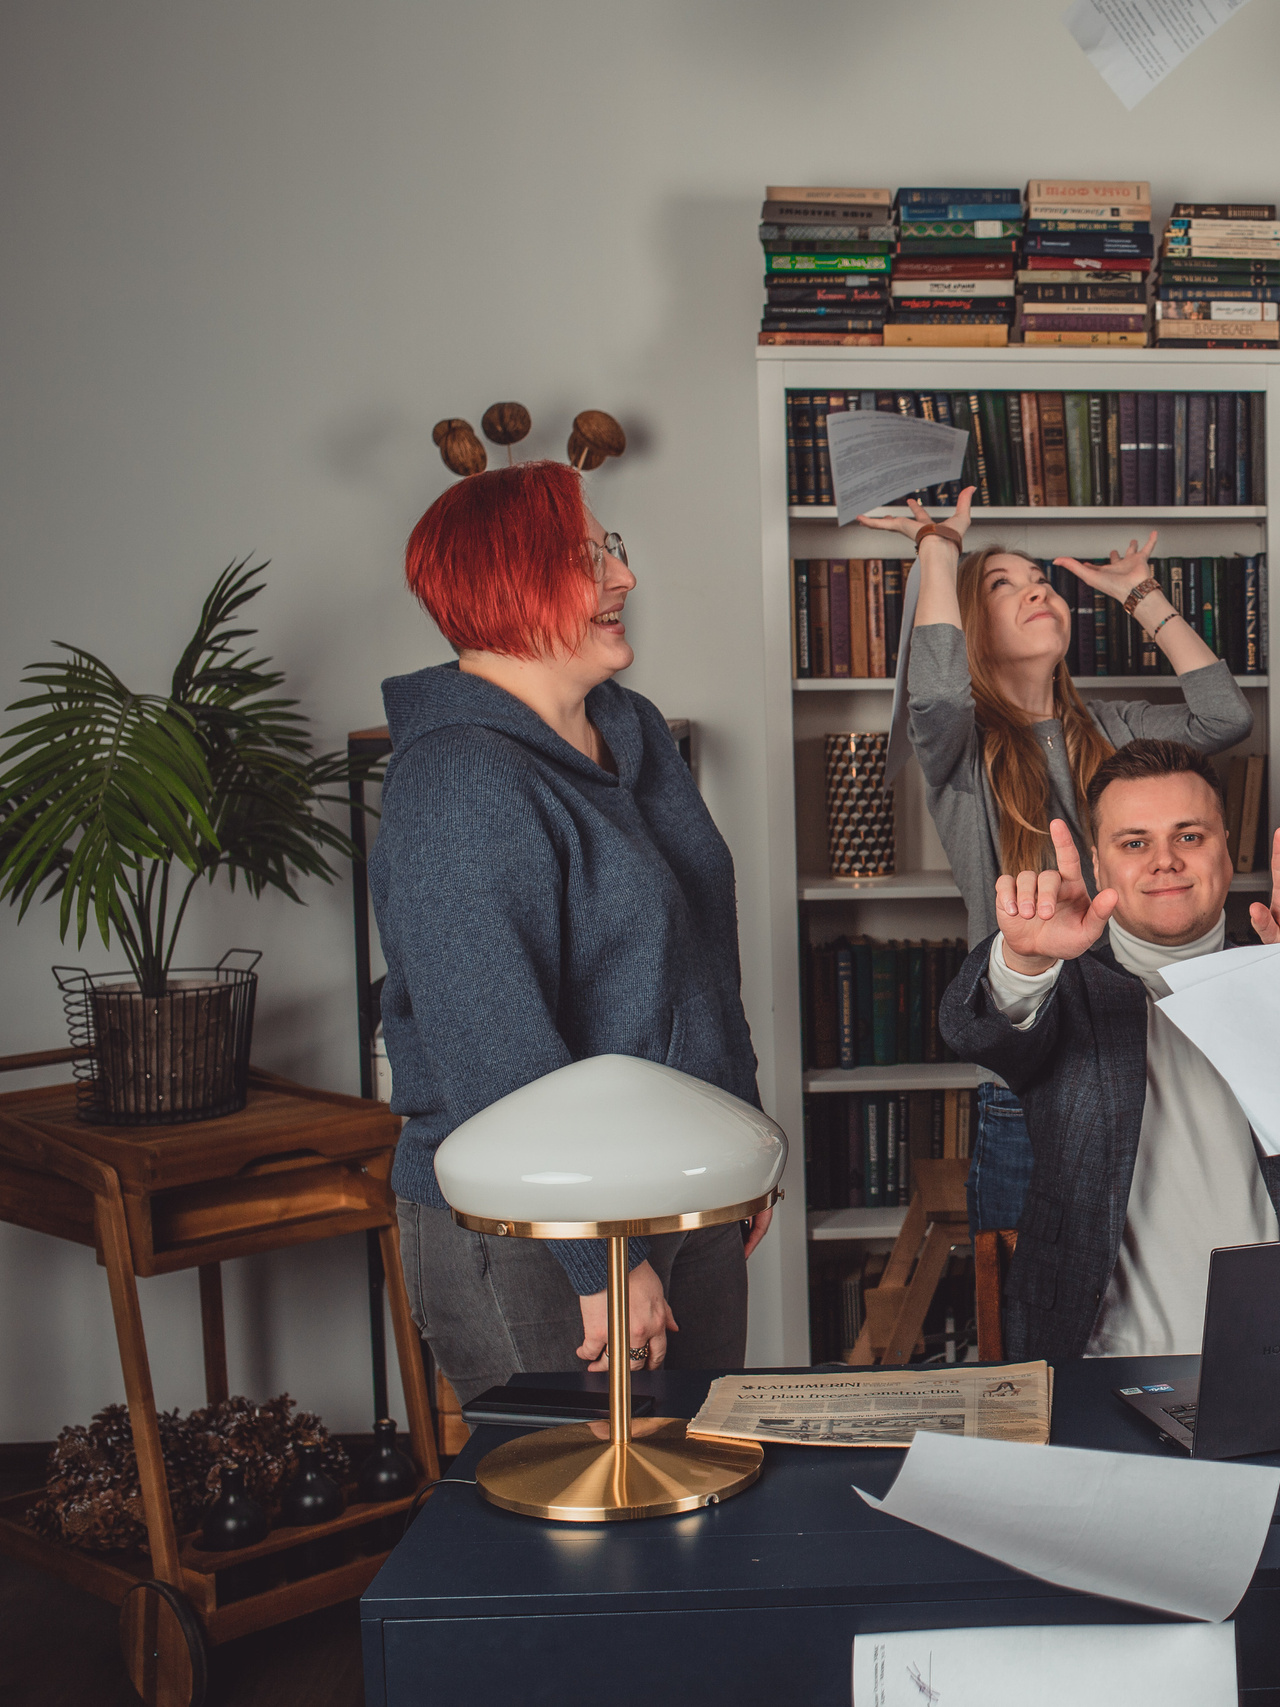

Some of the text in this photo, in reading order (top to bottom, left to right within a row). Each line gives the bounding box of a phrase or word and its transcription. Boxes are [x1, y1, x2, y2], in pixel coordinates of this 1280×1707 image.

[1045, 186, 1131, 197] ОЛЬГА ФОРШ
[757, 1382, 861, 1390] KATHIMERINI
[864, 1388, 960, 1397] construction
